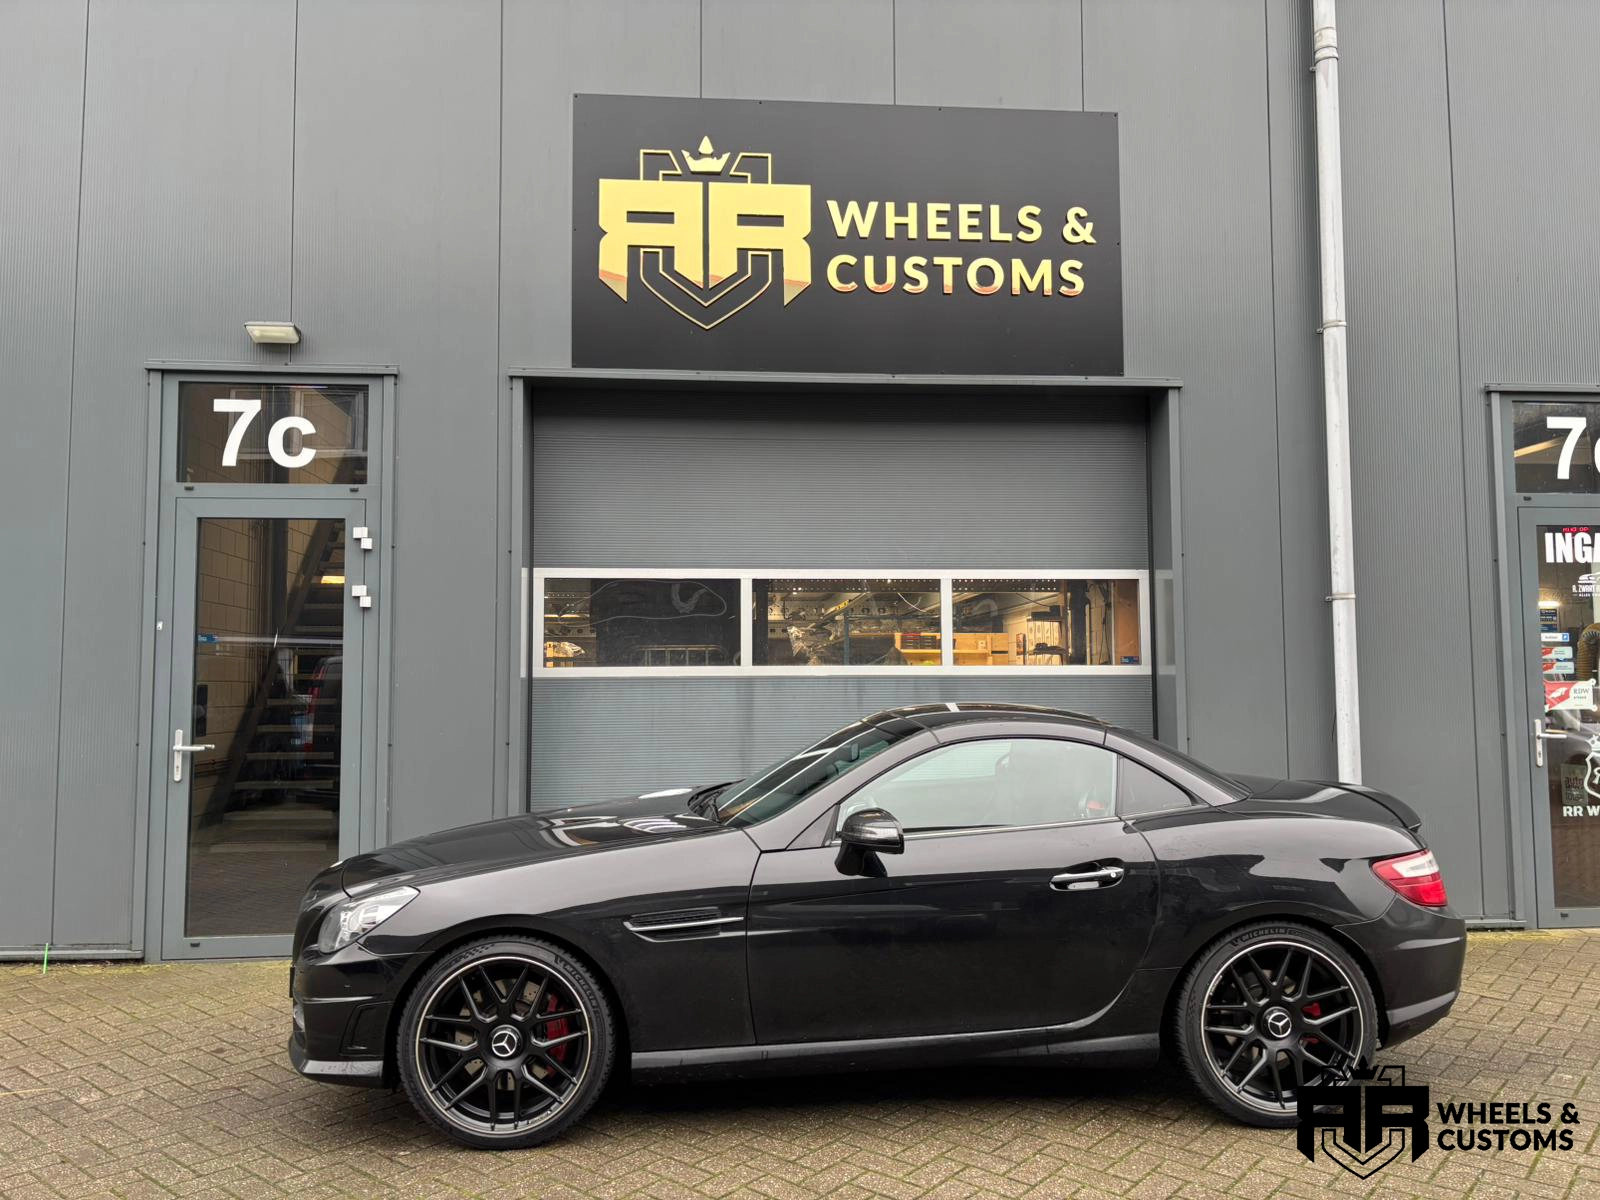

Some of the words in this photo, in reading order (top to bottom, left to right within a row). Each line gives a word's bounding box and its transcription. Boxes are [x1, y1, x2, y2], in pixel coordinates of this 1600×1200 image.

[826, 200, 1043, 243] WHEELS
[1062, 206, 1096, 244] &
[826, 254, 1085, 297] CUSTOMS
[213, 399, 317, 468] 7c
[1546, 416, 1600, 480] 7
[1563, 806, 1584, 817] RR
[1242, 927, 1285, 941] MICHELIN
[564, 964, 599, 1008] MICHELIN
